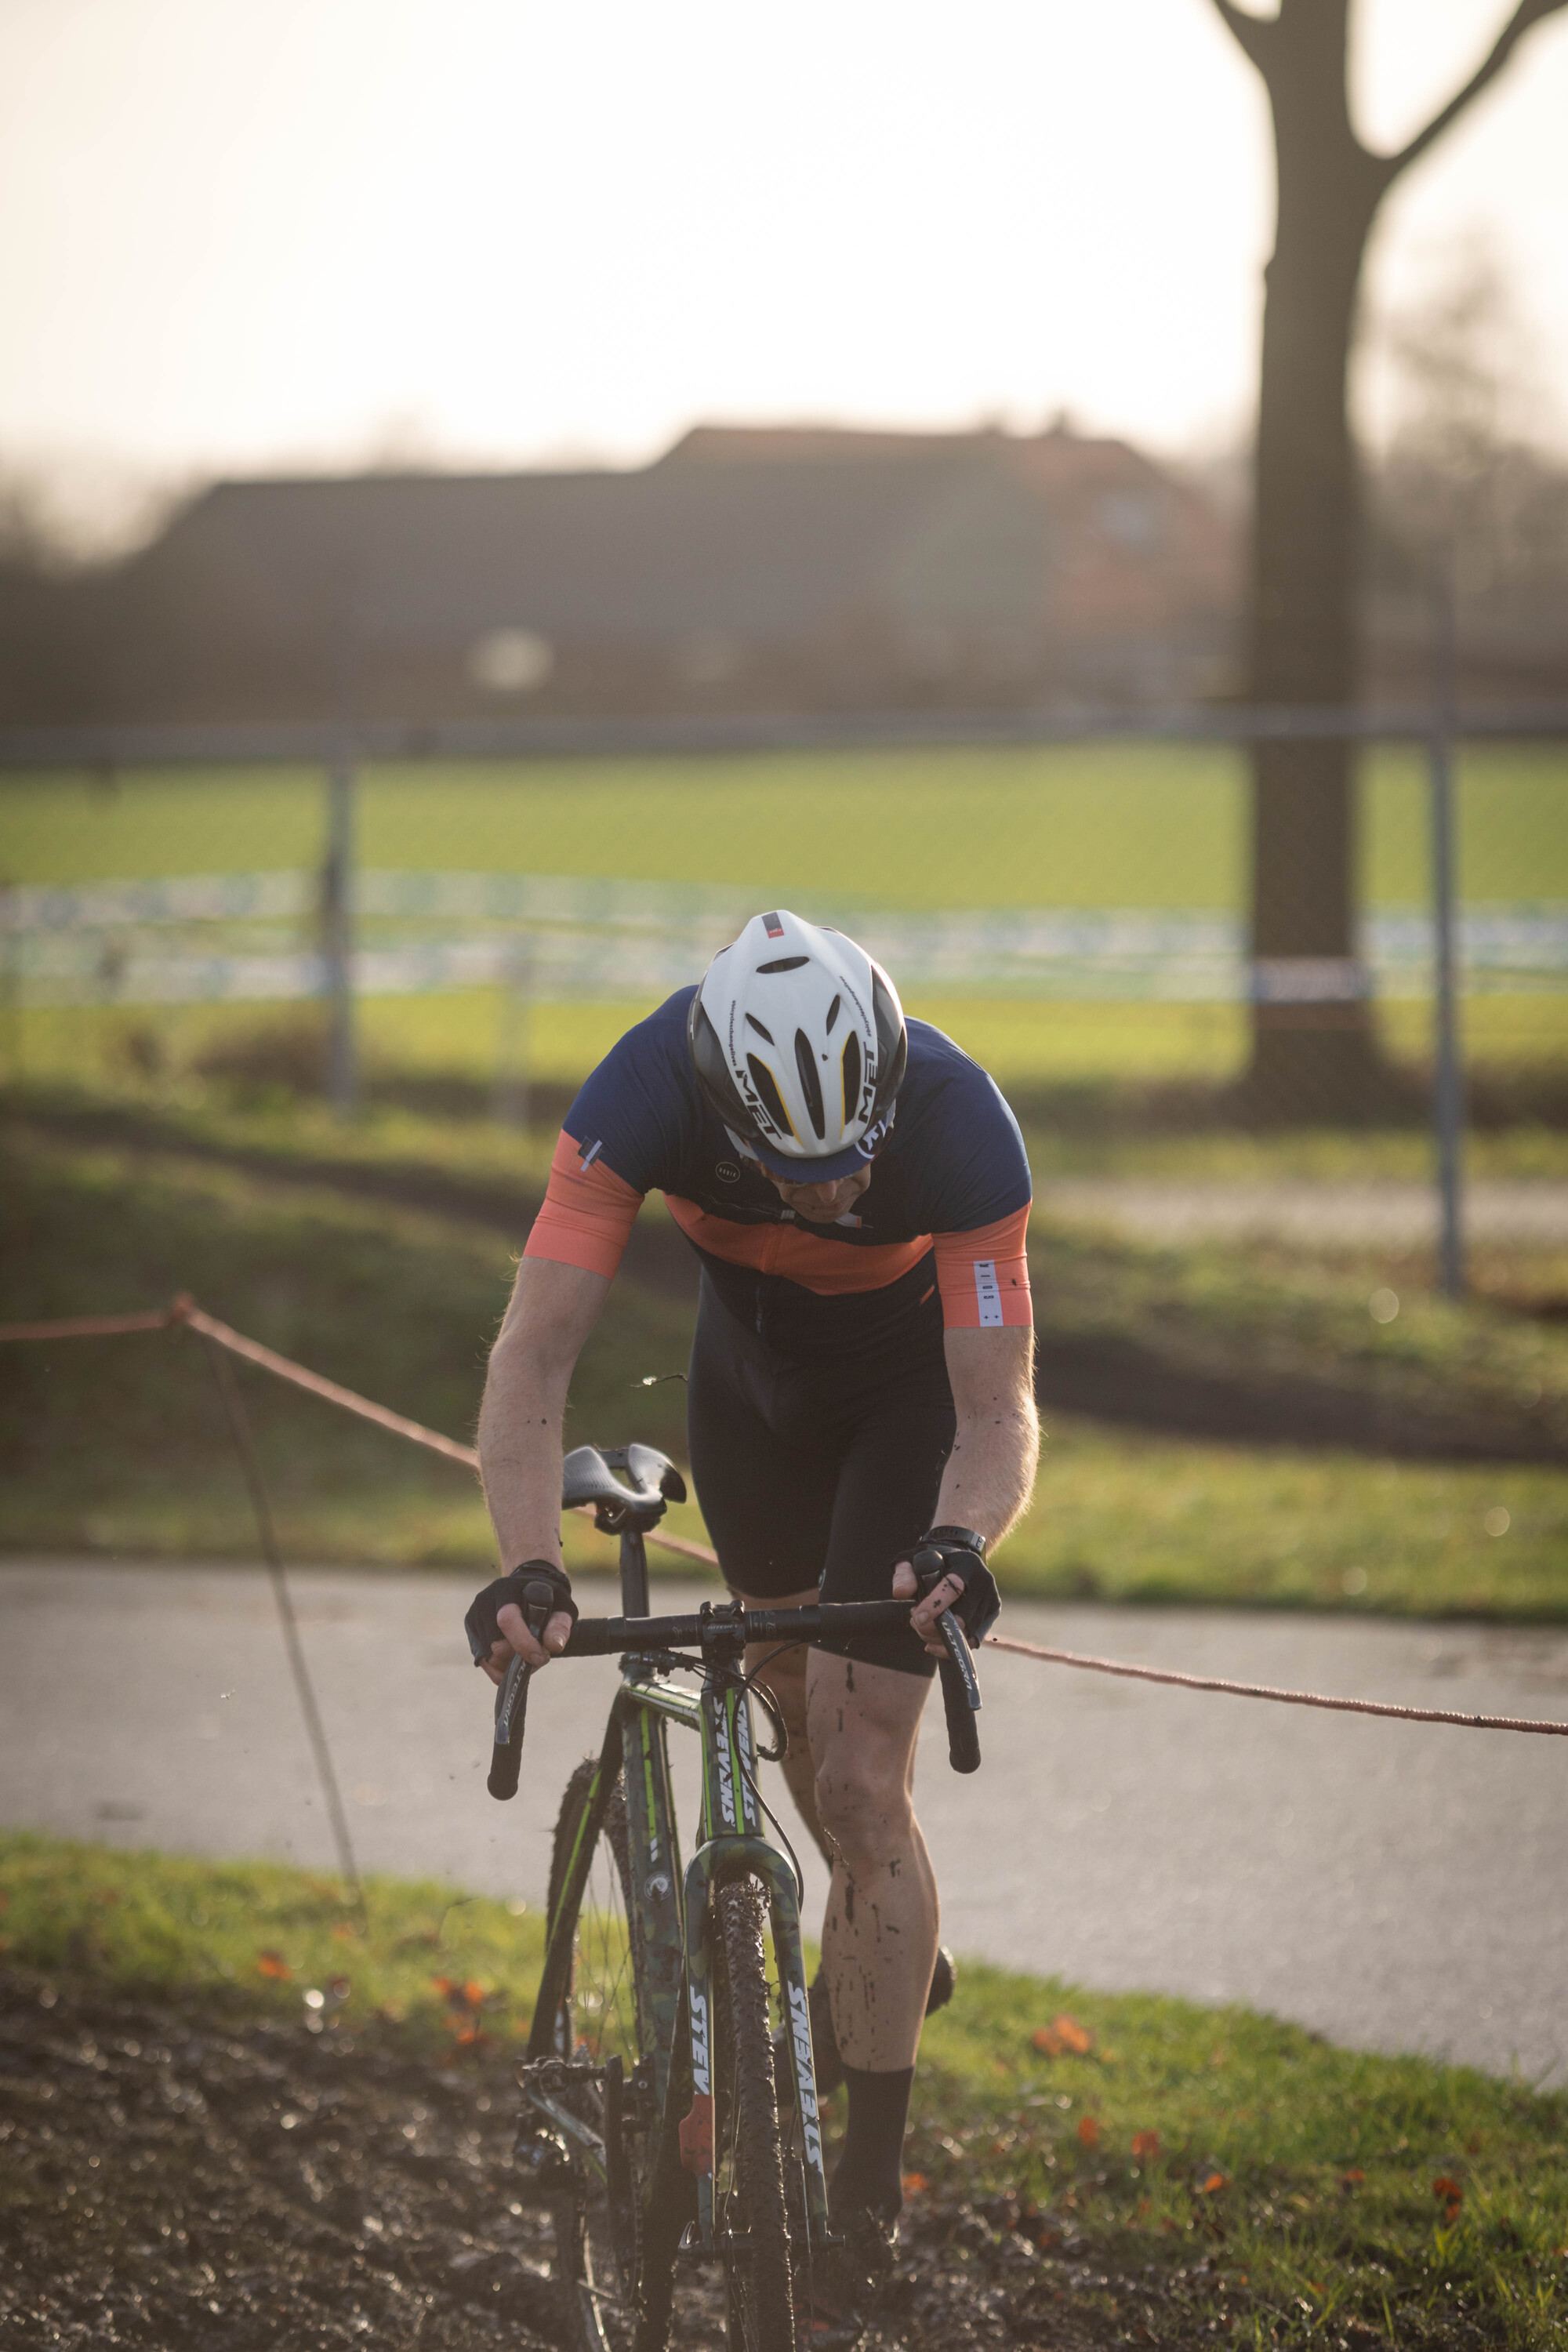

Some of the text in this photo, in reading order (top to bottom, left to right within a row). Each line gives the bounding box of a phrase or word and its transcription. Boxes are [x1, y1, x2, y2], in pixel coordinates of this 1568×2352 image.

[735, 1070, 782, 1140] MET
[858, 1041, 878, 1124] MET
[942, 1621, 972, 1690] ULTEGRA
[690, 1985, 710, 2096] STEV
[787, 1980, 822, 2176] STEVENS
